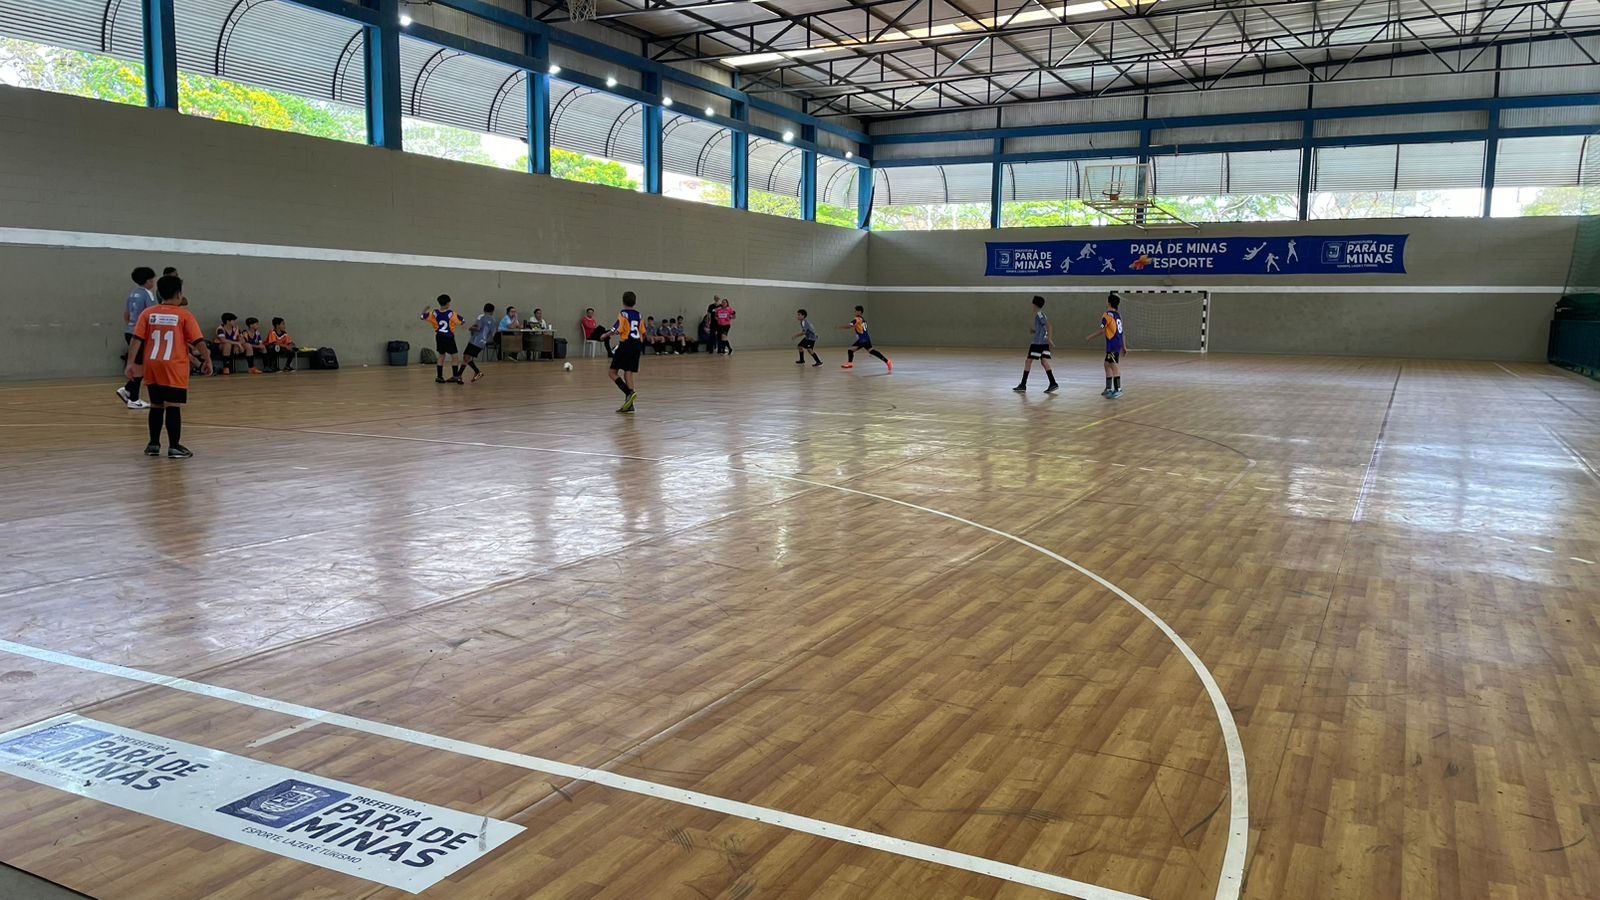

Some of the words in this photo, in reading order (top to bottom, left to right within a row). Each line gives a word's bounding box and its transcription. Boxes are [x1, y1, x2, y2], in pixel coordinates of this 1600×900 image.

[1015, 249, 1039, 260] PARÁ
[1040, 252, 1052, 260] DE
[1130, 241, 1163, 254] PARÁ
[1167, 243, 1183, 254] DE
[1186, 242, 1228, 254] MINAS
[1346, 241, 1377, 253] PARÁ
[1379, 244, 1394, 253] DE
[1014, 260, 1052, 270] MINAS
[1153, 257, 1214, 269] ESPORTE
[1346, 253, 1393, 264] MINAS
[438, 320, 449, 333] 2
[630, 320, 640, 339] 5
[150, 329, 174, 361] 11
[82, 740, 178, 767] PARÁ
[154, 758, 210, 778] DE
[47, 751, 176, 791] MINAS
[351, 795, 422, 818] PREFEITURA
[322, 802, 433, 837] PARÁ
[416, 826, 479, 850] DE
[282, 837, 314, 850] LAZER
[319, 848, 362, 864] TURISMO
[286, 816, 448, 868] MINAS
